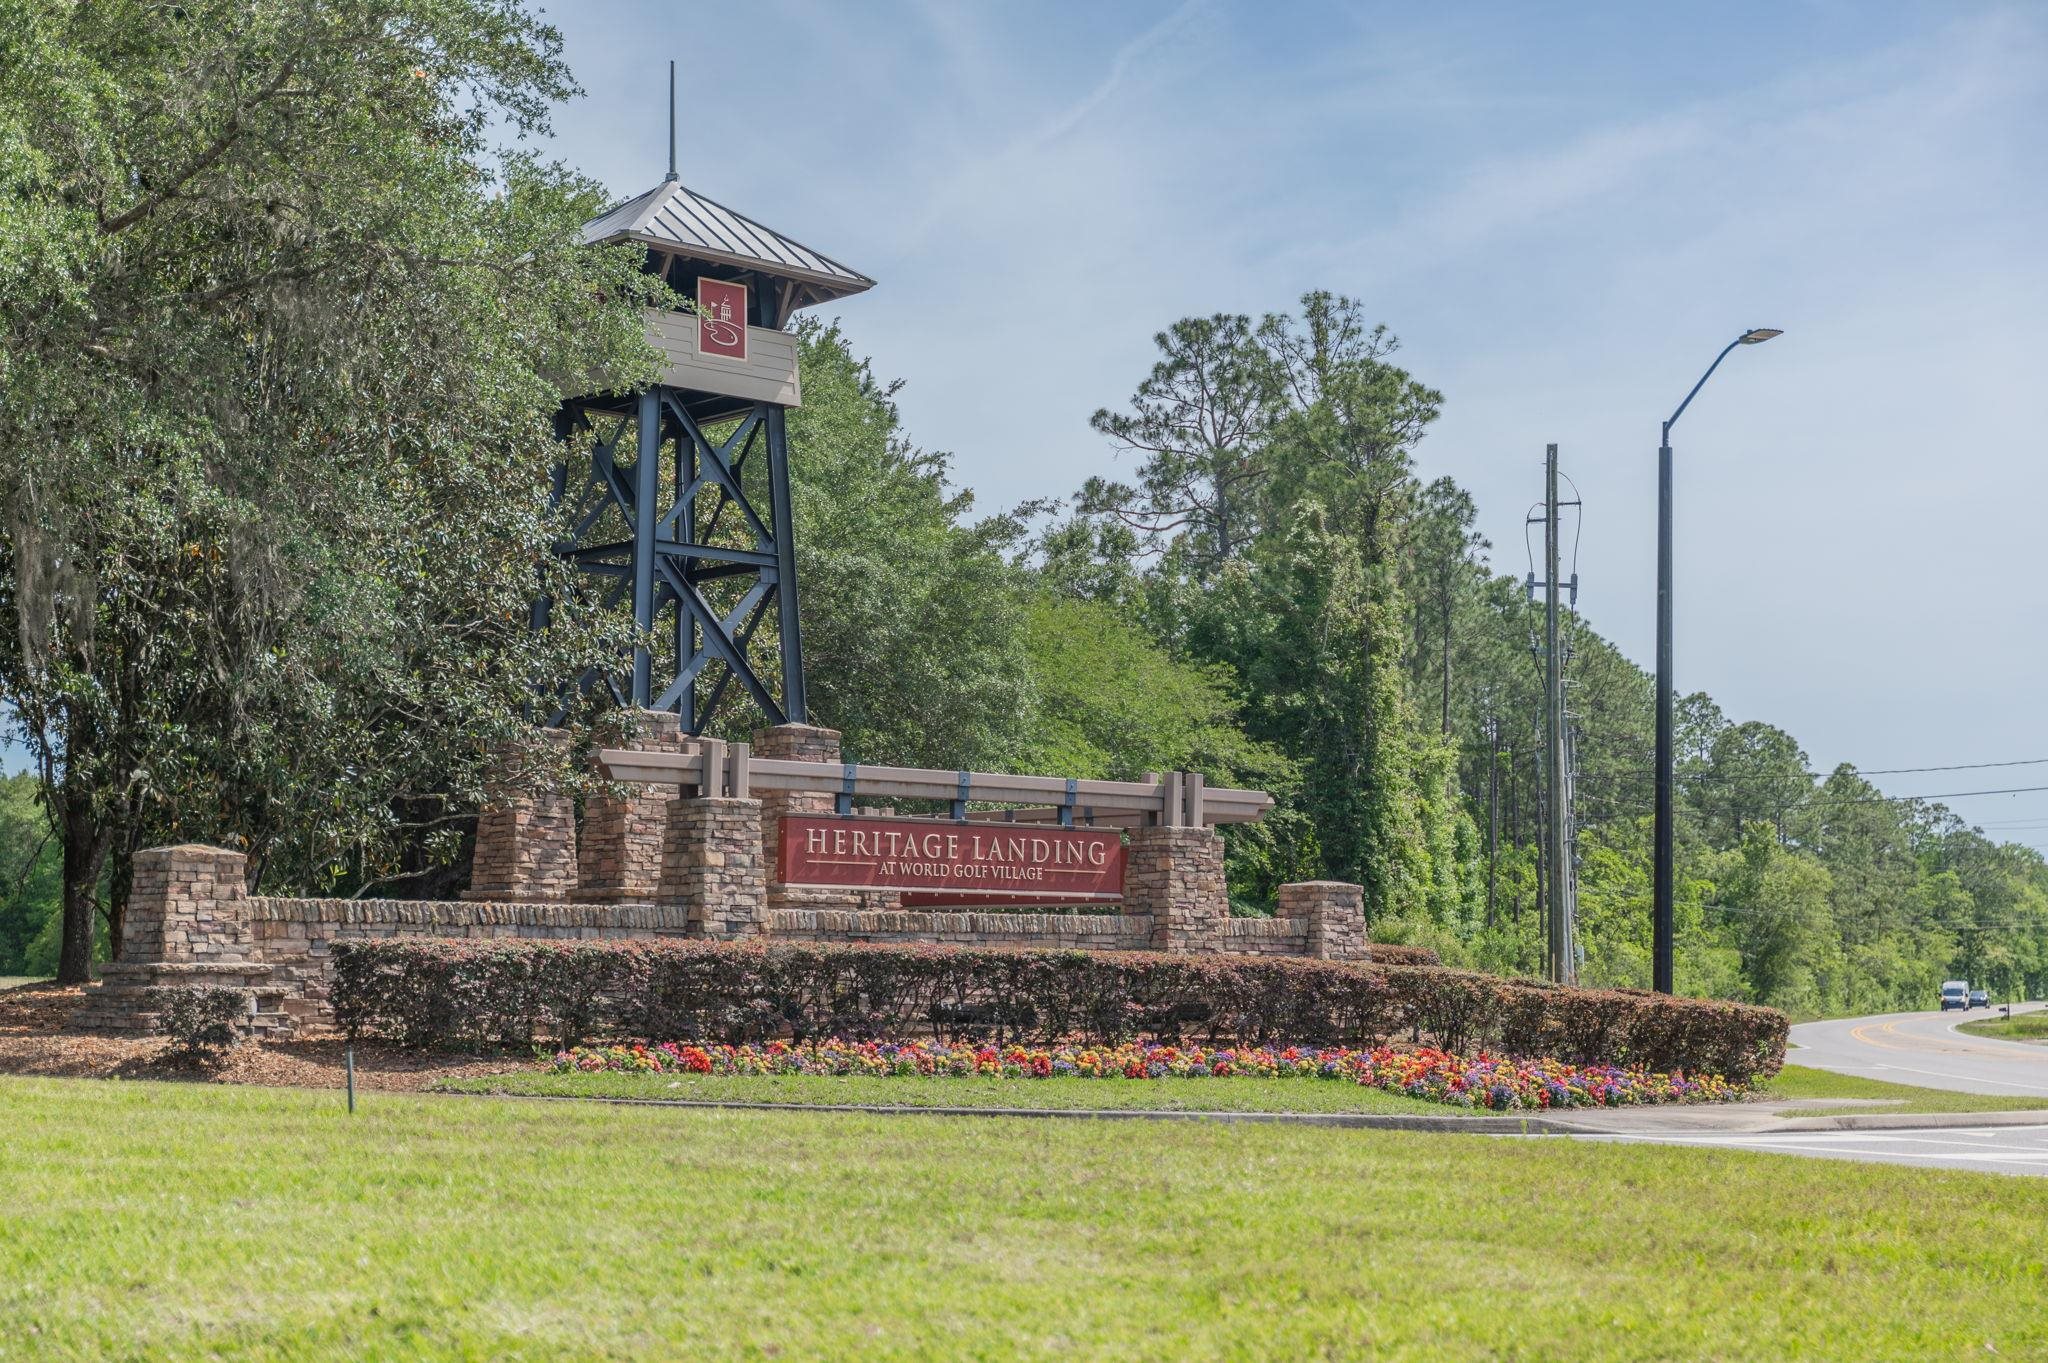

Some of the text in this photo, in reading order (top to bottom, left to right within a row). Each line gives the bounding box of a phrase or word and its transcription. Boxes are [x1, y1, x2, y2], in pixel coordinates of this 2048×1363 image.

[806, 828, 1106, 866] HERITAGE LANDING
[878, 861, 1043, 880] AT WORLD GOLF VILLAGE
